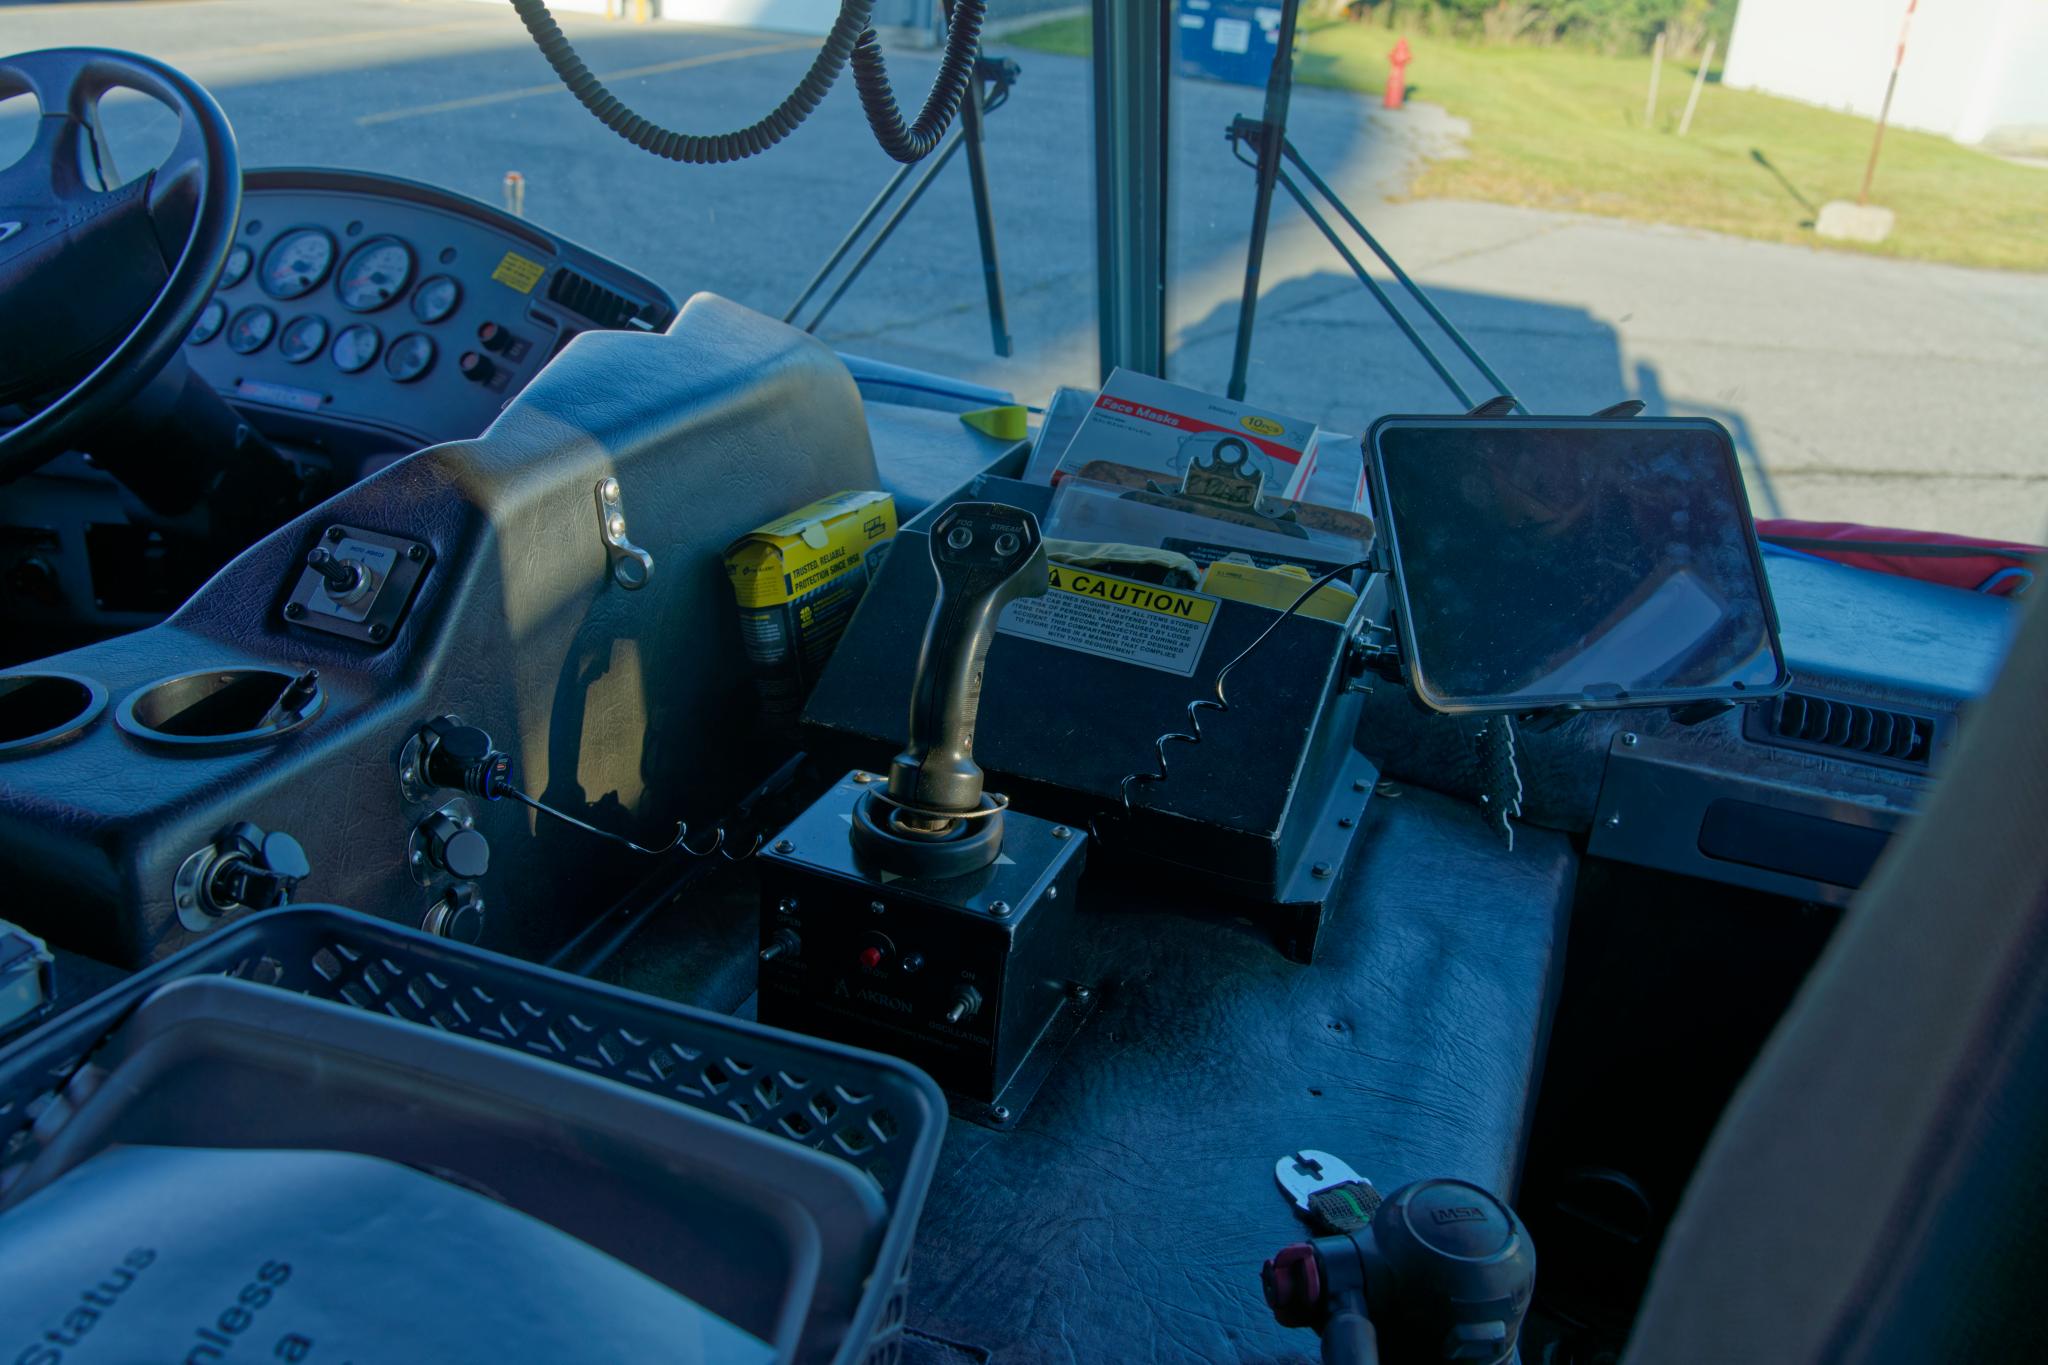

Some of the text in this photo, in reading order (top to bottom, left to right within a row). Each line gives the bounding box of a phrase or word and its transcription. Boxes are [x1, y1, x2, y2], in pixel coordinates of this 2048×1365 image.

[1101, 398, 1133, 415] Face
[1137, 407, 1180, 427] Masks
[819, 546, 847, 565] RELIABLE
[795, 570, 830, 590] PROTECTION
[1072, 575, 1193, 615] CAUTION
[1046, 591, 1078, 602] IDELINES
[1112, 606, 1131, 614] THAT
[1146, 614, 1168, 623] ITEMS
[1169, 619, 1199, 630] STORED
[1059, 606, 1097, 619] PERSONAL
[1097, 615, 1123, 625] INJURY
[1124, 622, 1154, 632] CAUSED
[1166, 631, 1192, 641] LOOSE
[1110, 612, 1148, 624] FASTENED
[1160, 623, 1190, 634] REDUCE
[1025, 618, 1049, 628] STORE
[1049, 624, 1072, 633] ITEMS
[1120, 640, 1138, 649] THAT
[1139, 645, 1177, 658] COMPLIES
[1033, 607, 1053, 616] THAT
[1069, 615, 1099, 626] BECOME
[1100, 623, 1149, 638] PROJECTILES
[1149, 634, 1178, 645] DURING
[1046, 631, 1064, 639] WITH
[1065, 635, 1083, 643] THIS
[1067, 622, 1121, 638] COMPARTMENT
[1130, 636, 1145, 644] NOT
[1146, 640, 1184, 653] DESIGNED
[961, 970, 976, 981] ON
[857, 988, 913, 1014] AKRON
[928, 1020, 991, 1047] OSCILLATION
[1438, 1208, 1484, 1220] MSA
[14, 1246, 157, 1365] Status
